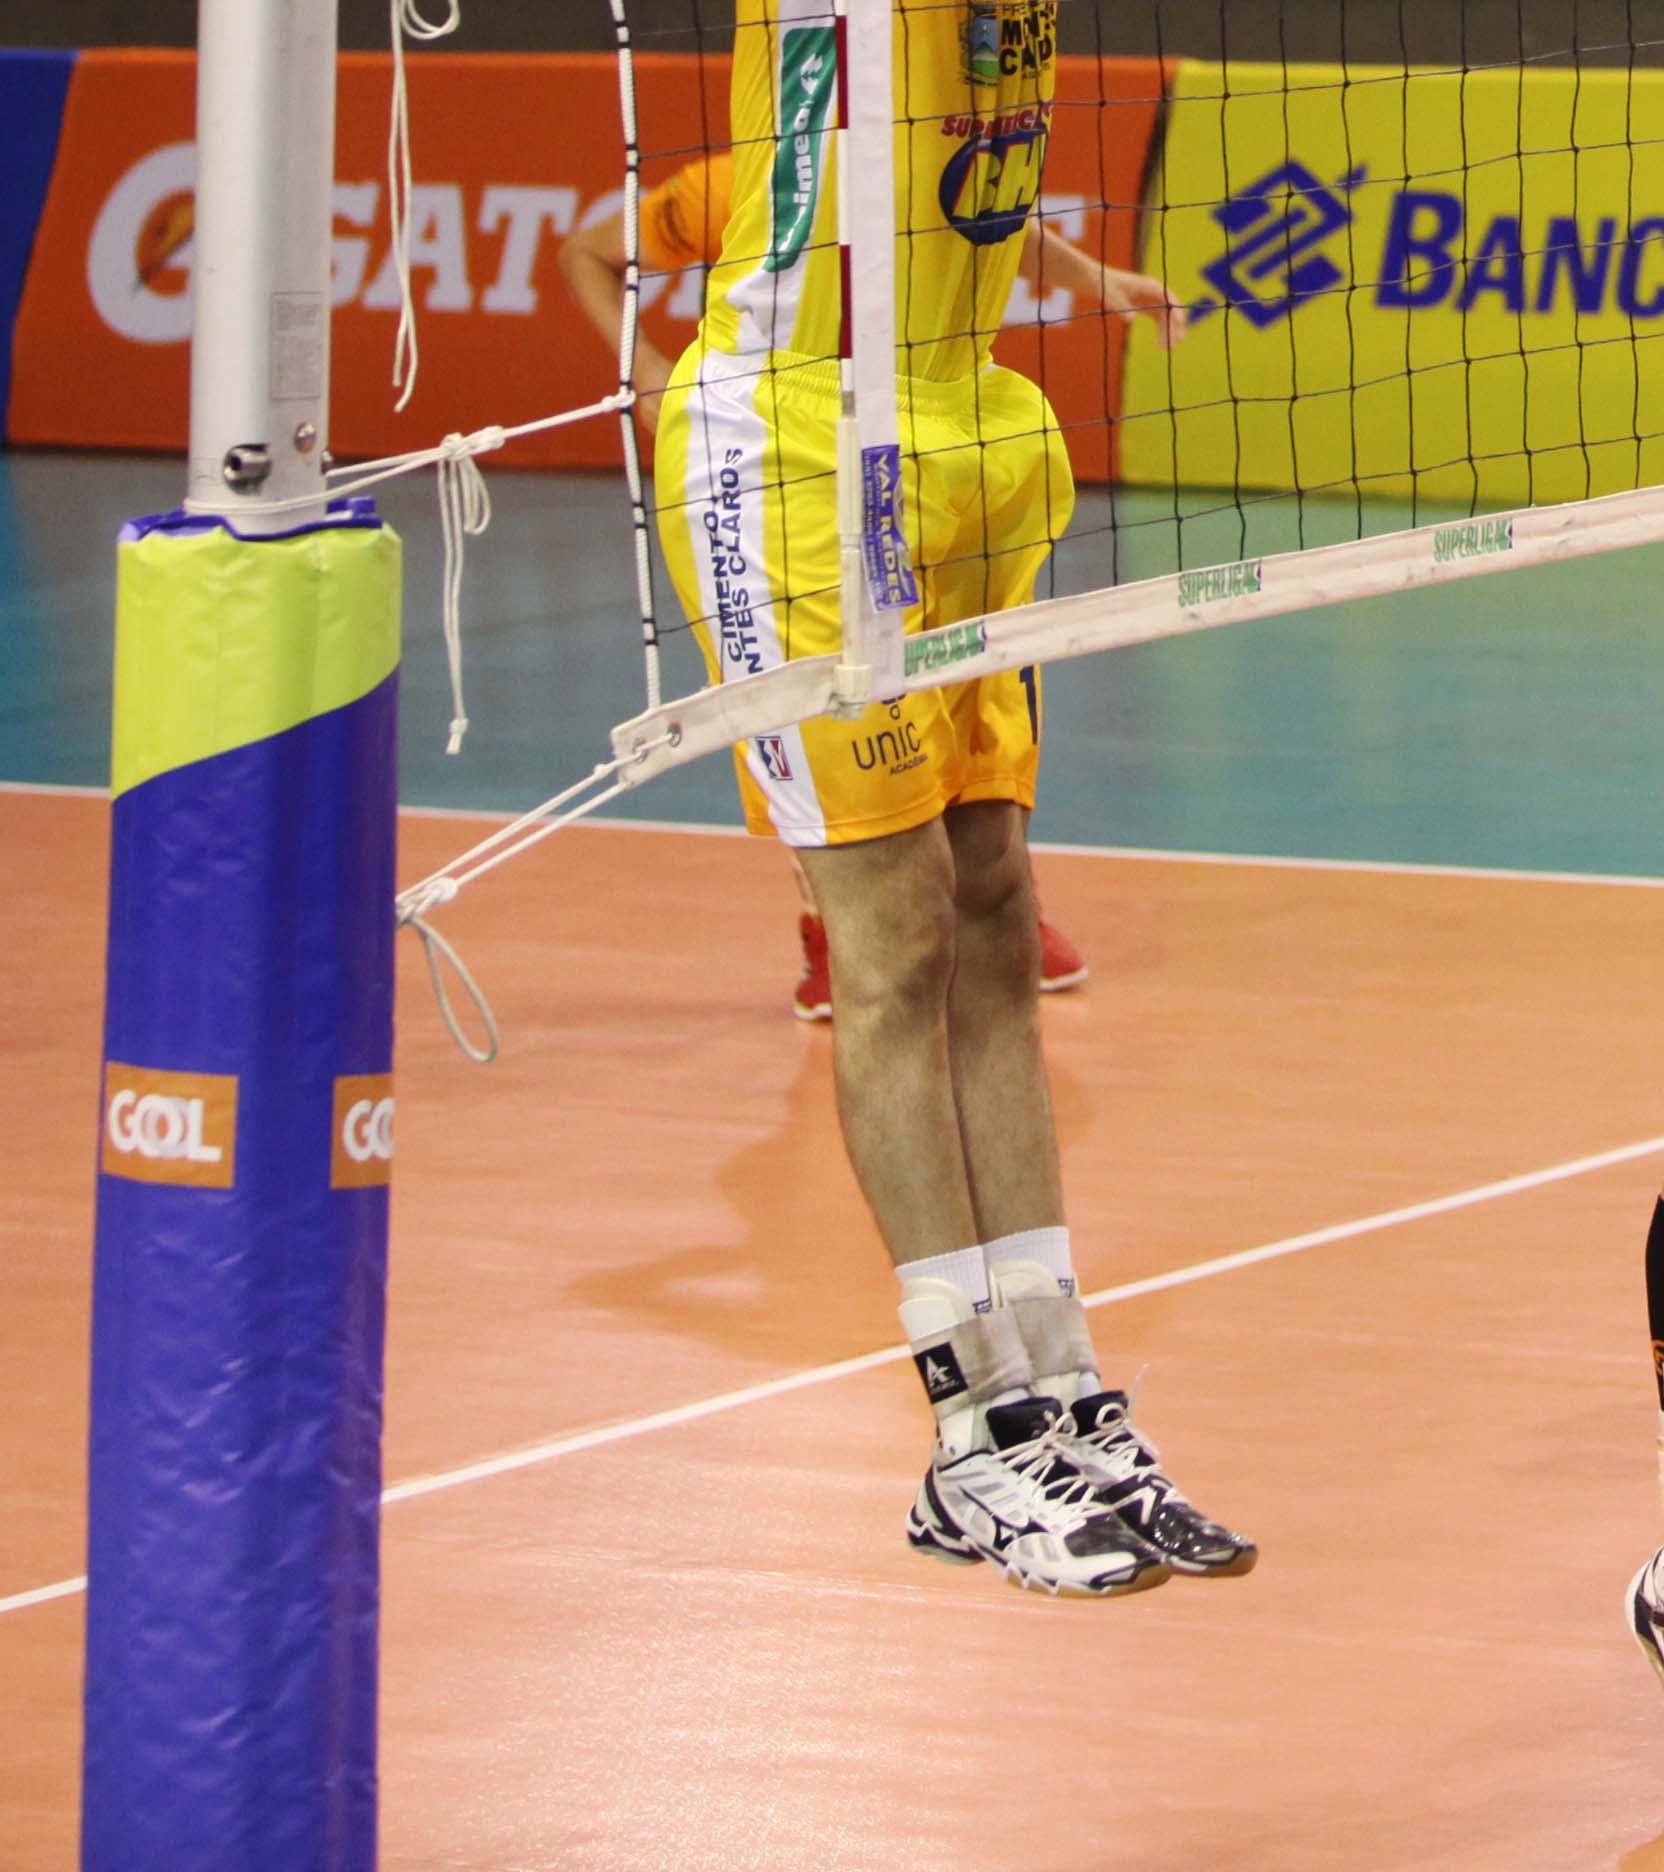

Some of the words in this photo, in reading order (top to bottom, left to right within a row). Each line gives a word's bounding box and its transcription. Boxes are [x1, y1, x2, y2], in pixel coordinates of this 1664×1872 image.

[722, 448, 746, 576] CLAROS
[876, 453, 893, 507] VAL
[705, 508, 742, 663] CIMENTO
[903, 622, 985, 676] UPERLIGA
[1178, 562, 1261, 609] SUPERLIGA
[1434, 519, 1512, 563] SUPERLIGA
[733, 591, 763, 674] NTES
[853, 719, 922, 770] unic
[107, 1088, 223, 1164] GOL
